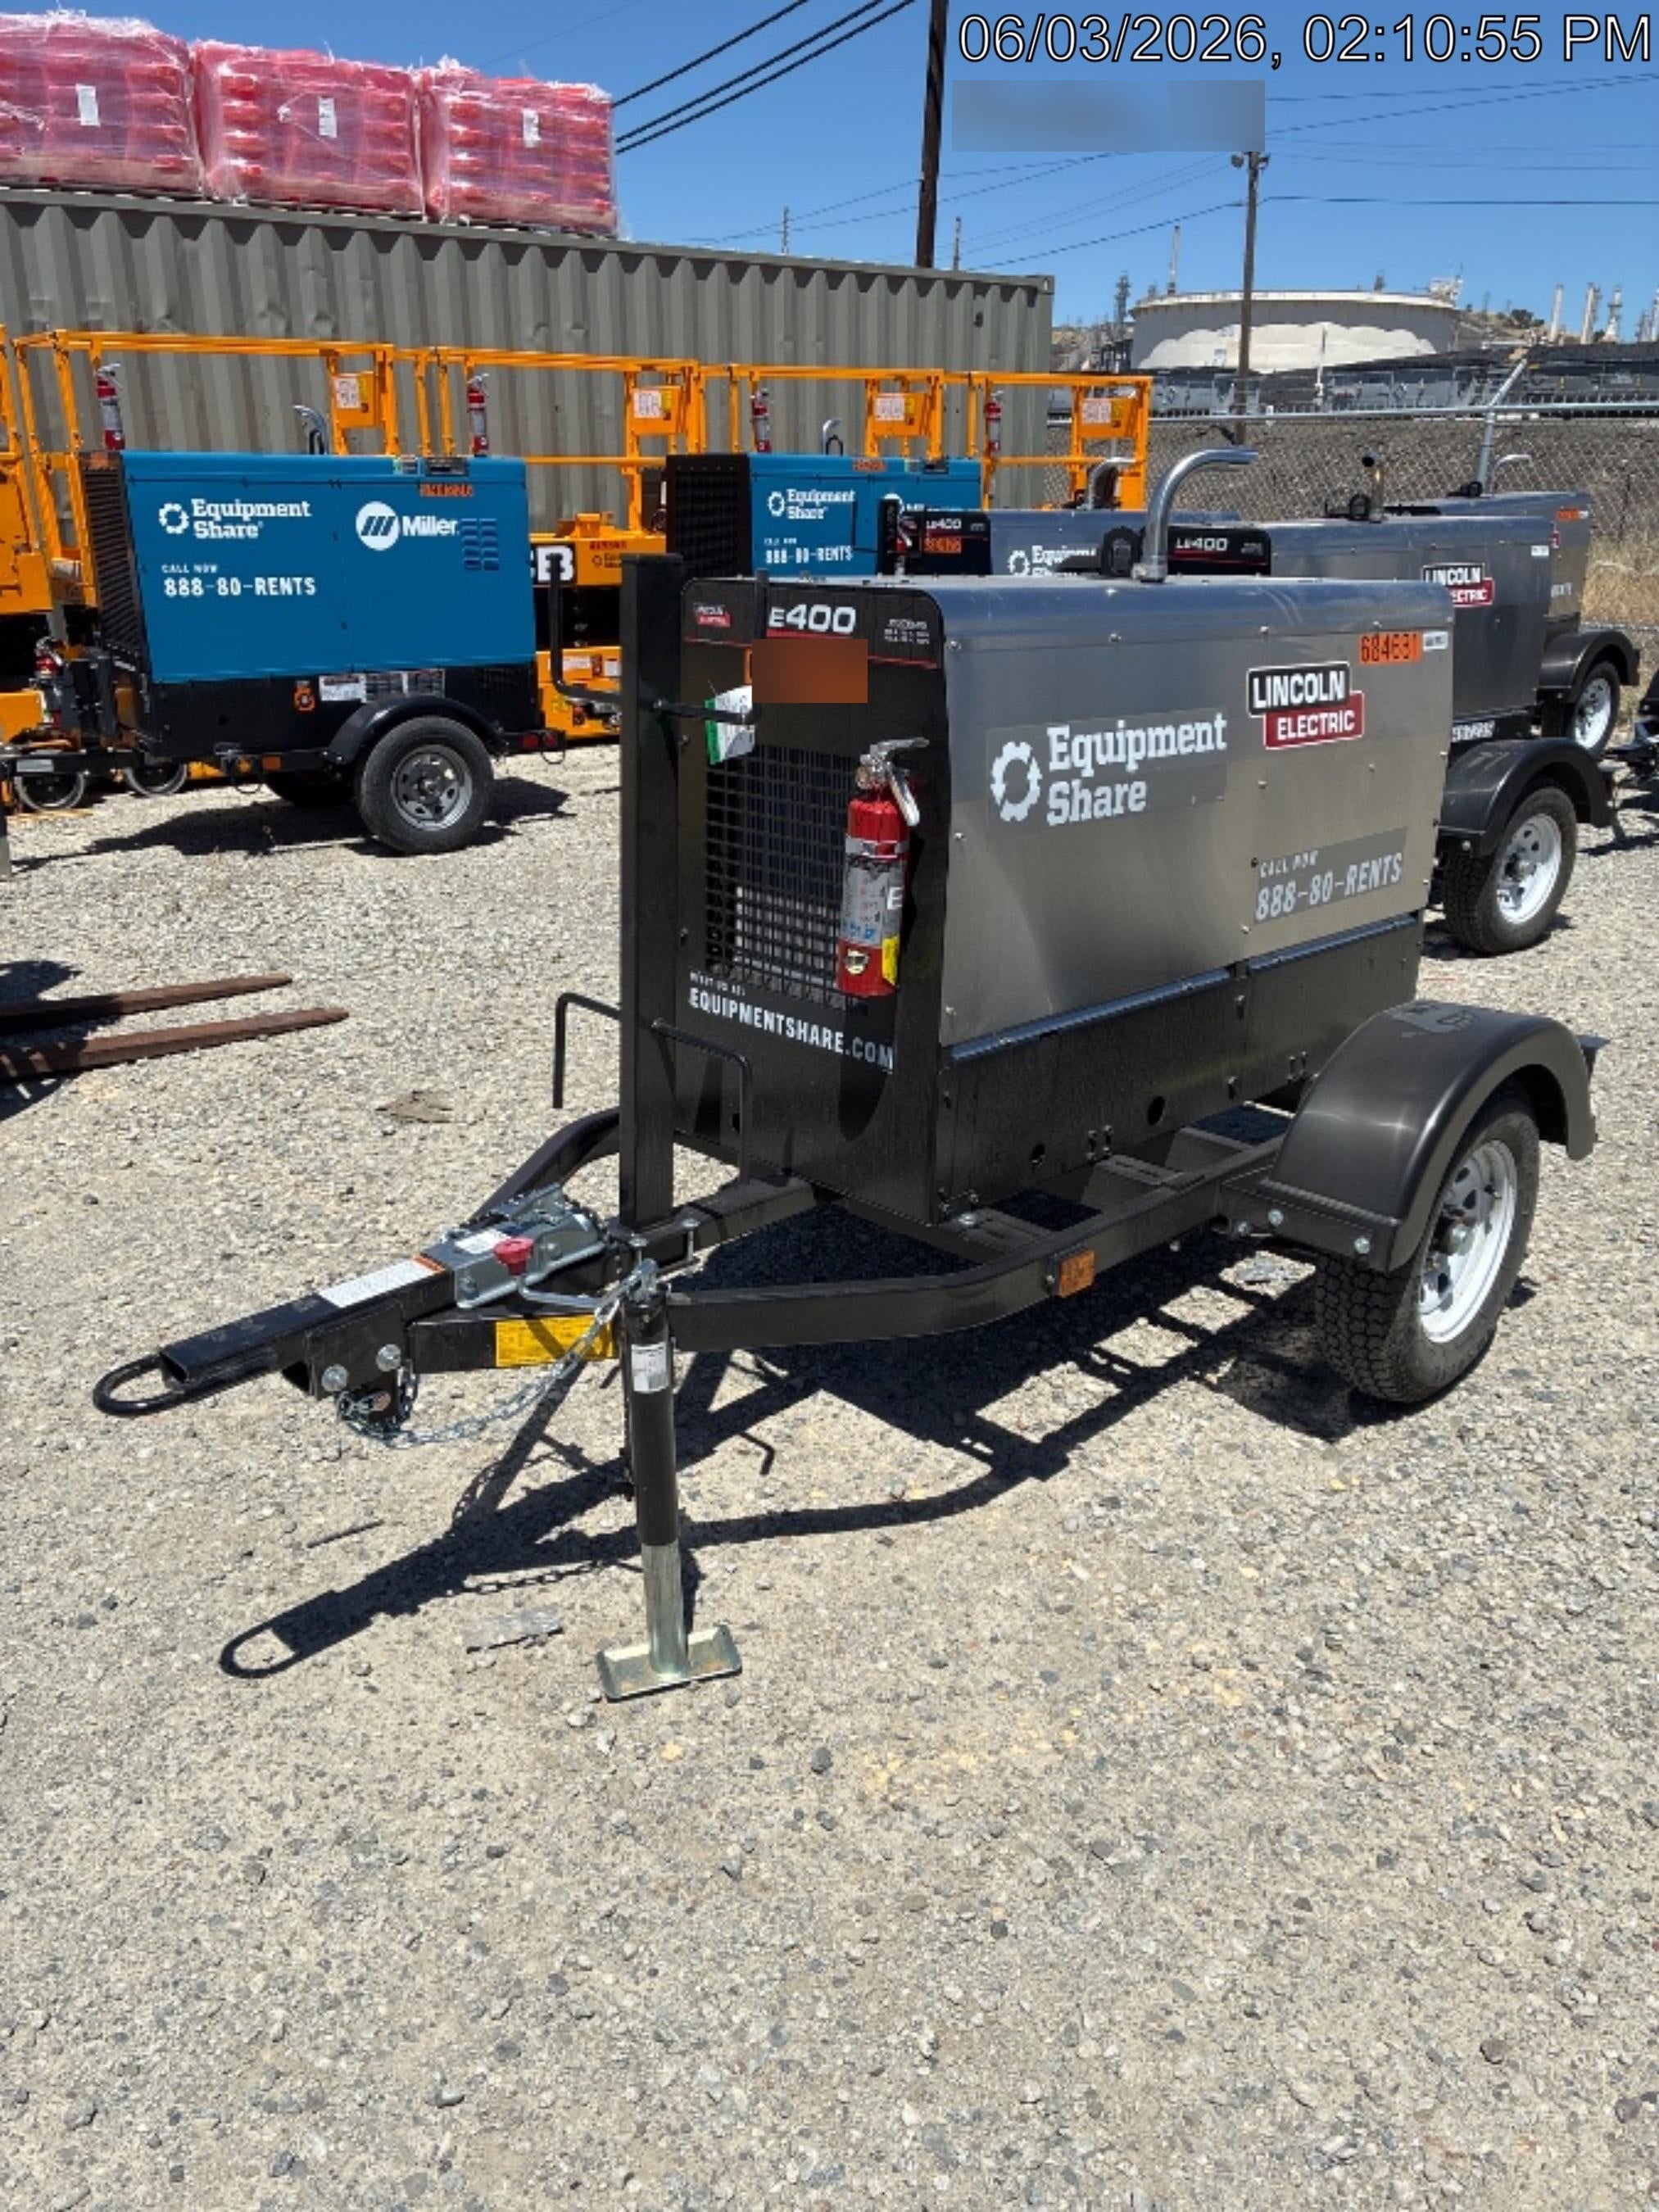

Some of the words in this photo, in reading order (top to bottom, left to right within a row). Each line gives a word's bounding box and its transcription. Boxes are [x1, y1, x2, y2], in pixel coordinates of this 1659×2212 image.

[191, 498, 311, 521] Equipment
[401, 516, 457, 537] Miller
[193, 521, 259, 539] Share
[164, 577, 316, 598] 888-80-RENTS
[1253, 670, 1346, 709] LINCOLN
[1277, 709, 1355, 741] ELECTRIC
[1046, 712, 1227, 777] Equipment
[1046, 778, 1148, 827] Share
[1255, 852, 1403, 921] 888-80-RENTS
[689, 987, 894, 1070] EQUIPMENTSHARE.COM
